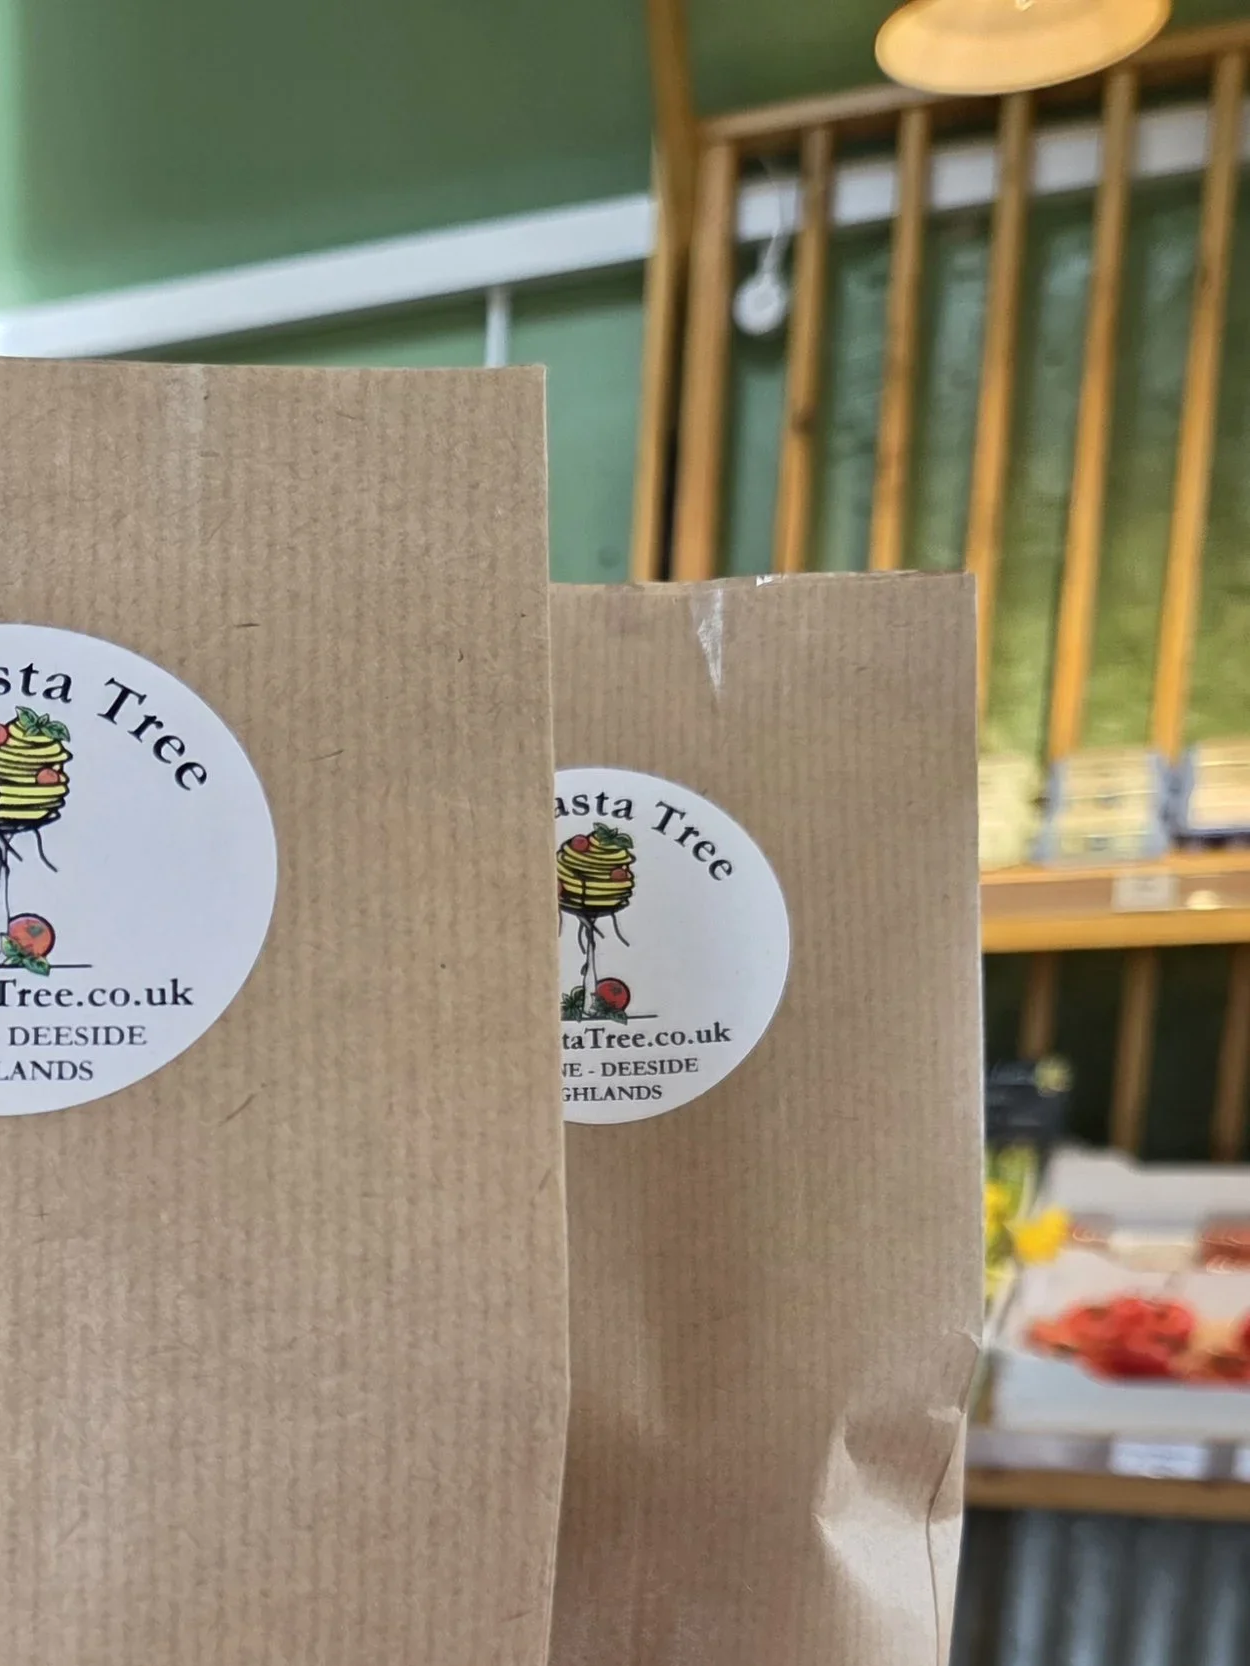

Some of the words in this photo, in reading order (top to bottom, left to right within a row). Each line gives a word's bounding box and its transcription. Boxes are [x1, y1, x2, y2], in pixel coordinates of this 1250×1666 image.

[97, 678, 208, 791] Tree
[554, 791, 634, 821] asta
[650, 801, 733, 882] Tree
[8, 1025, 148, 1047] DEESIDE
[562, 1022, 732, 1050] taTree.co.uk
[601, 1058, 699, 1078] DEESIDE
[562, 1085, 662, 1101] GHLANDS
